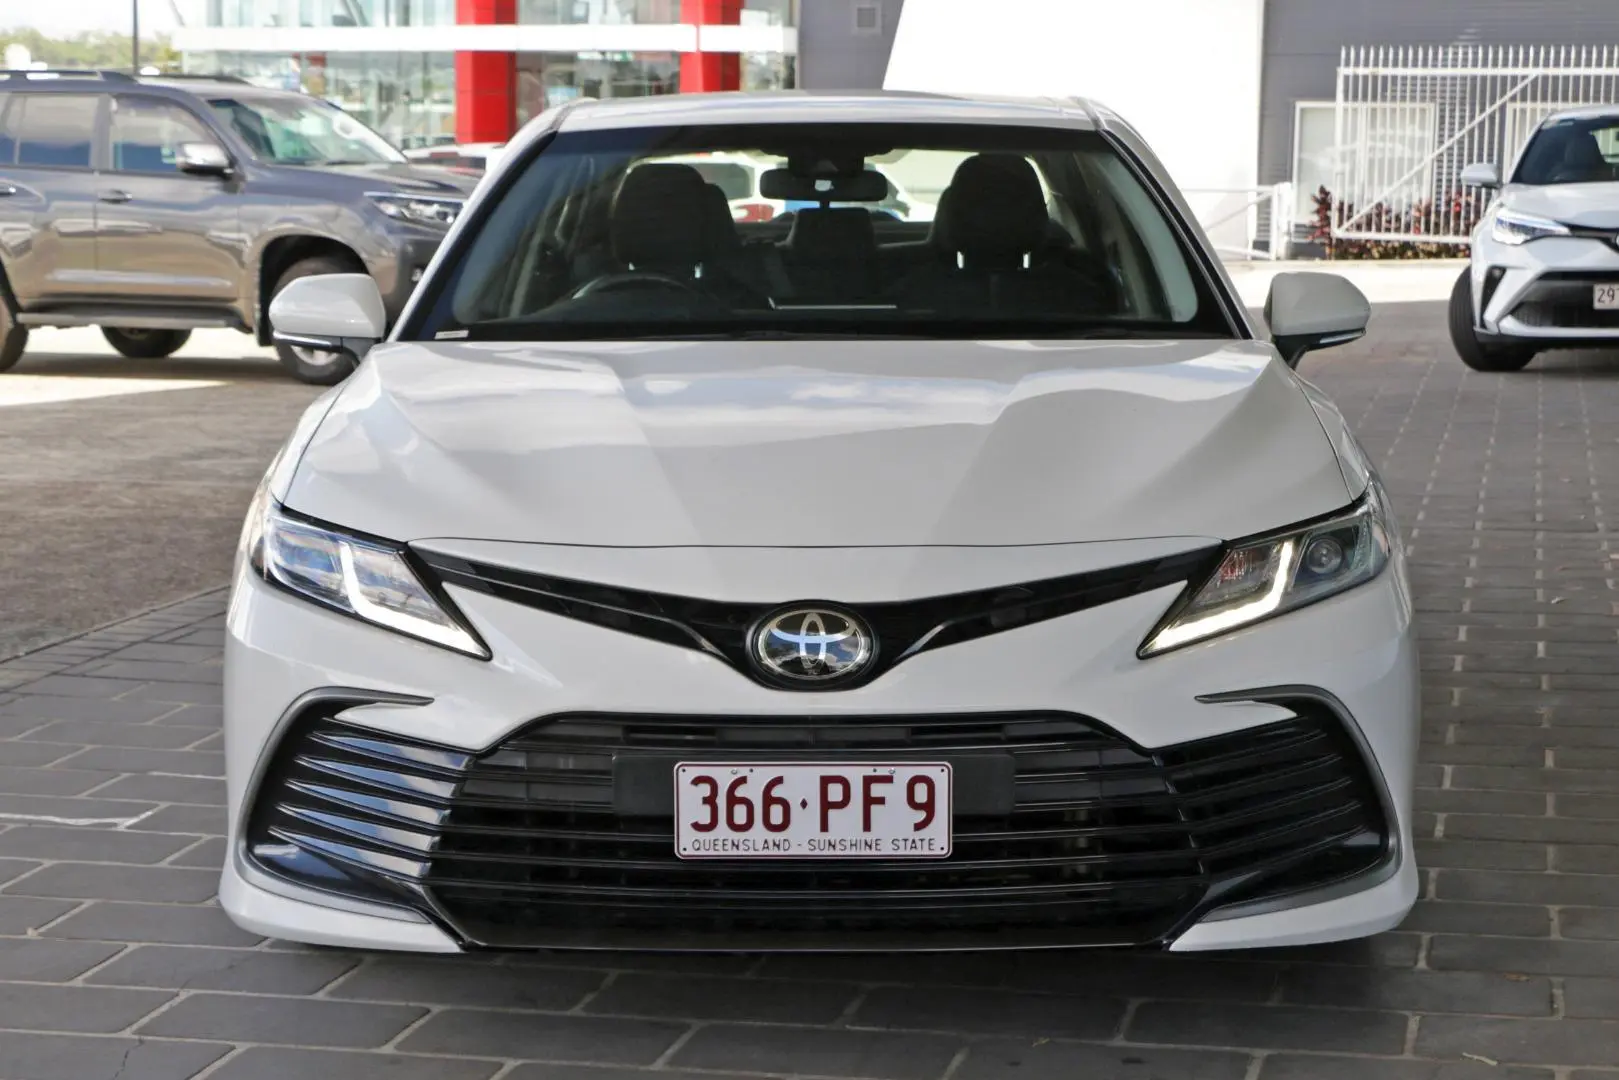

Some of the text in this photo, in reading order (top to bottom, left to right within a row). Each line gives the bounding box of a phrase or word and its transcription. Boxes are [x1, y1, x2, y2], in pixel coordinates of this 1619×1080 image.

[1597, 287, 1619, 303] 29
[691, 838, 791, 852] QUEENSLAND
[807, 838, 882, 851] SUNSHINE
[891, 838, 936, 851] STATE
